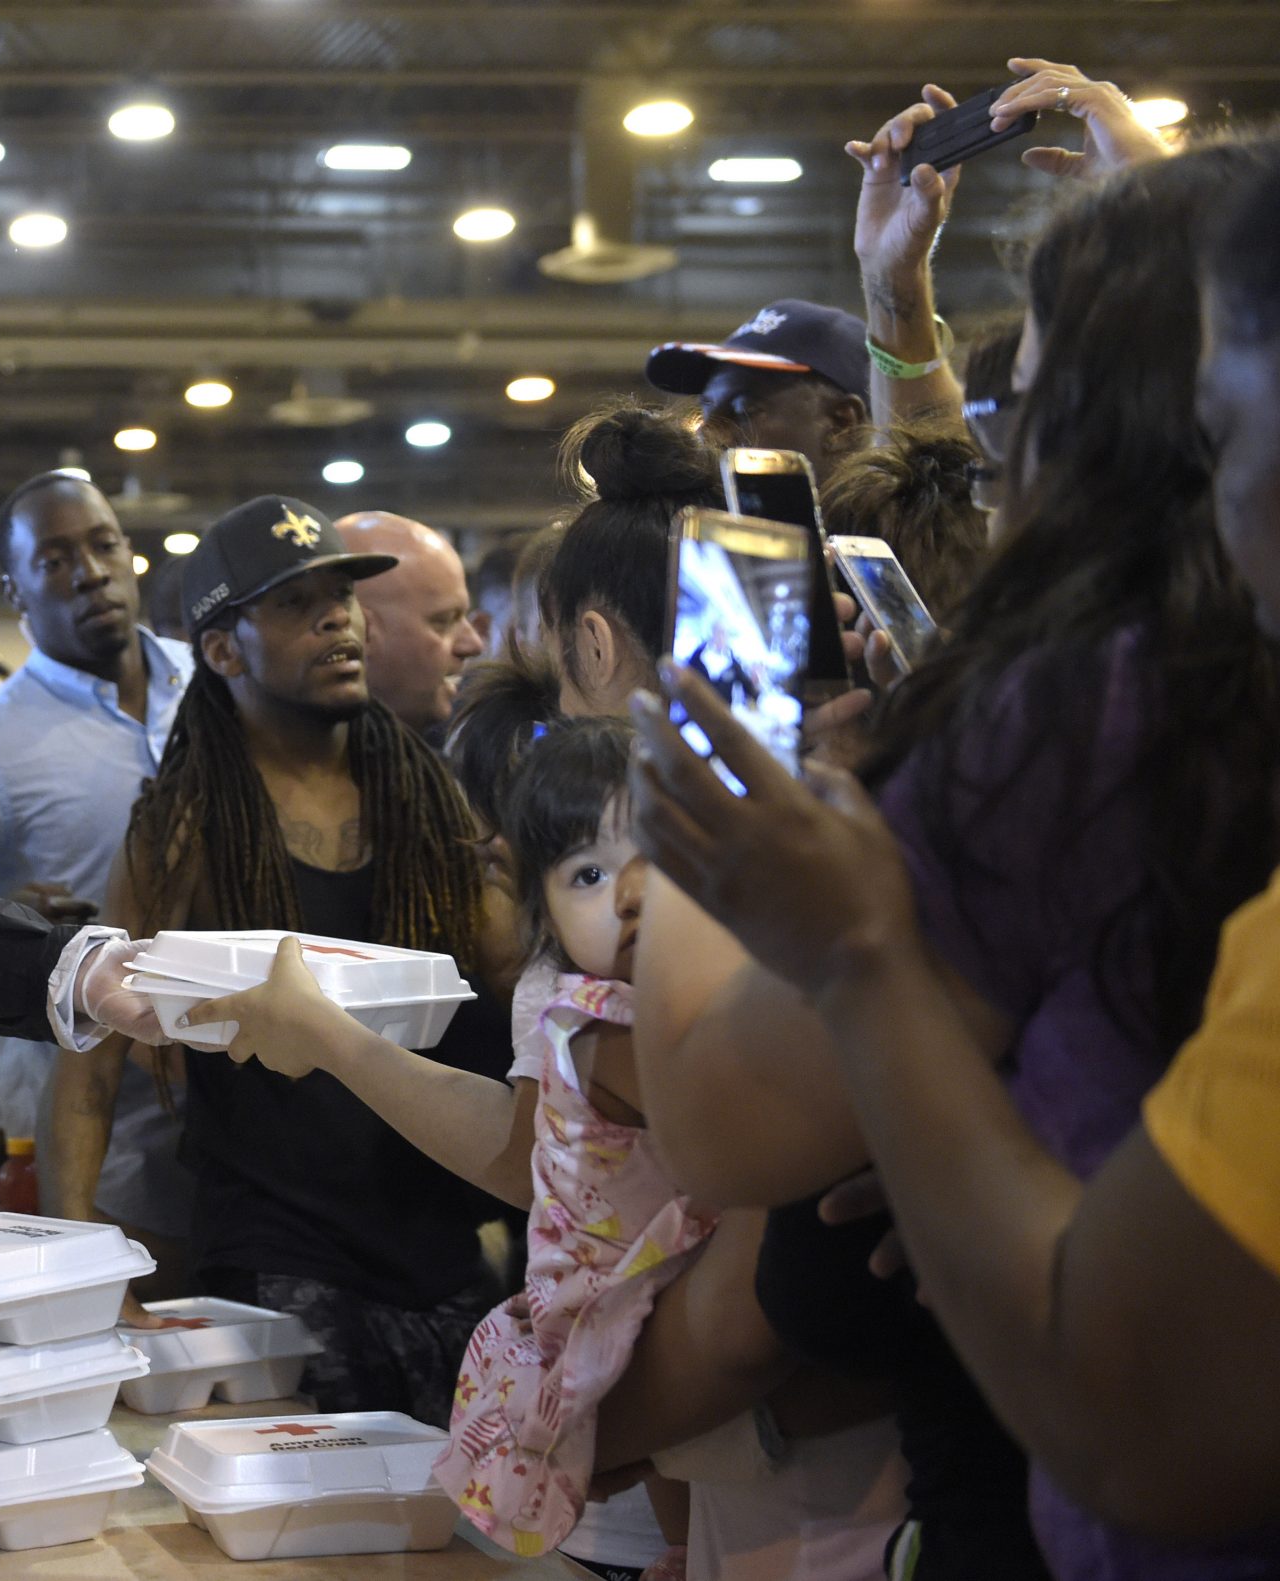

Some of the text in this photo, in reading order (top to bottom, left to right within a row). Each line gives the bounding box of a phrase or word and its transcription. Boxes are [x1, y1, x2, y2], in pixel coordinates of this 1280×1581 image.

[192, 582, 230, 620] SAINTS
[269, 1437, 363, 1448] American
[312, 1440, 368, 1449] Cross
